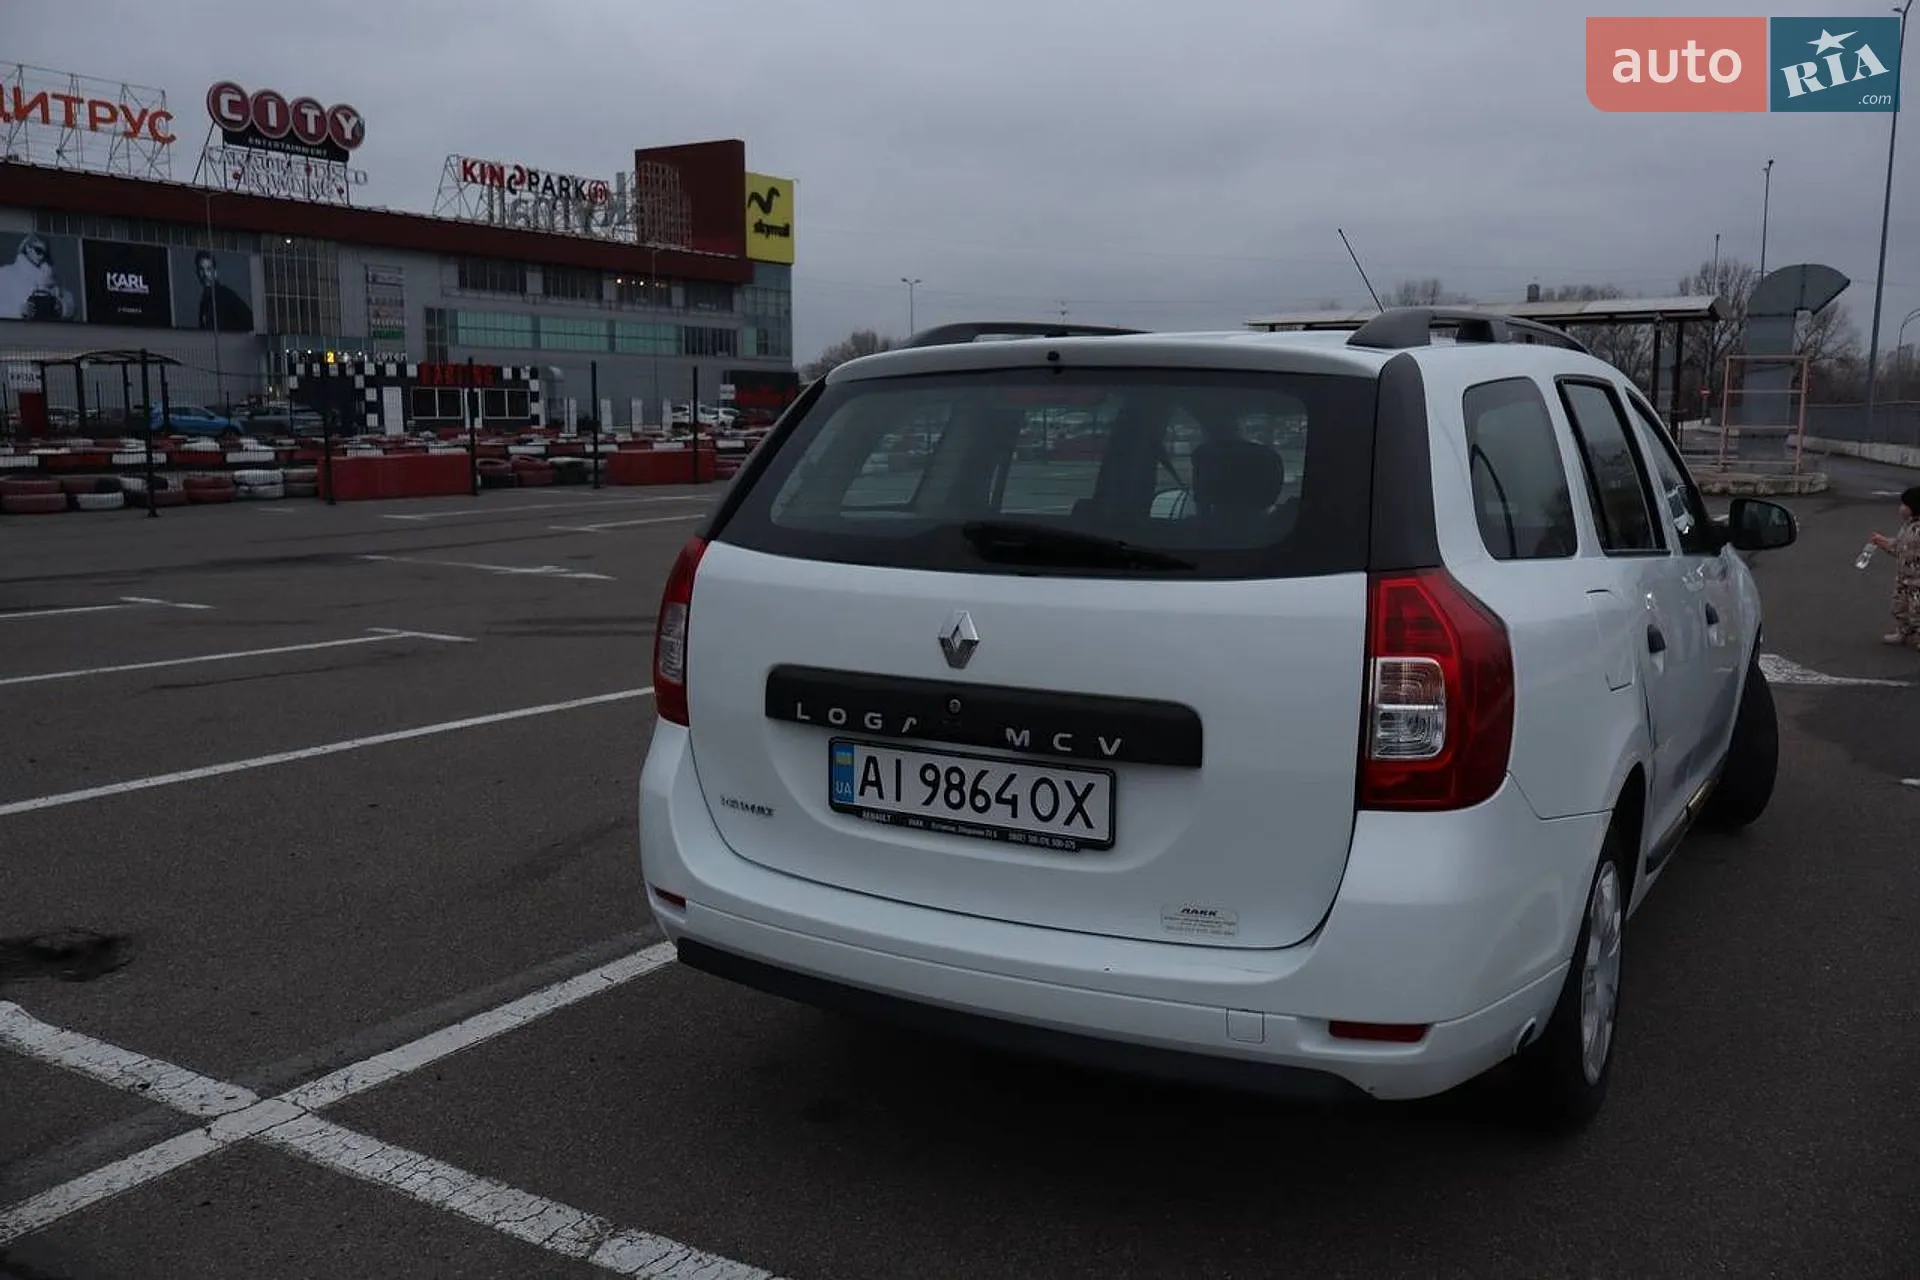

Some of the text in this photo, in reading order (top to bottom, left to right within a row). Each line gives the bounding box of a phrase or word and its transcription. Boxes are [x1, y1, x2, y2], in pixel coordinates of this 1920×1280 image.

[0, 83, 177, 144] ИТРУС
[218, 92, 358, 140] CITY
[107, 272, 148, 289] KARL
[835, 780, 853, 798] UA
[858, 755, 1096, 830] AI 9864 OX
